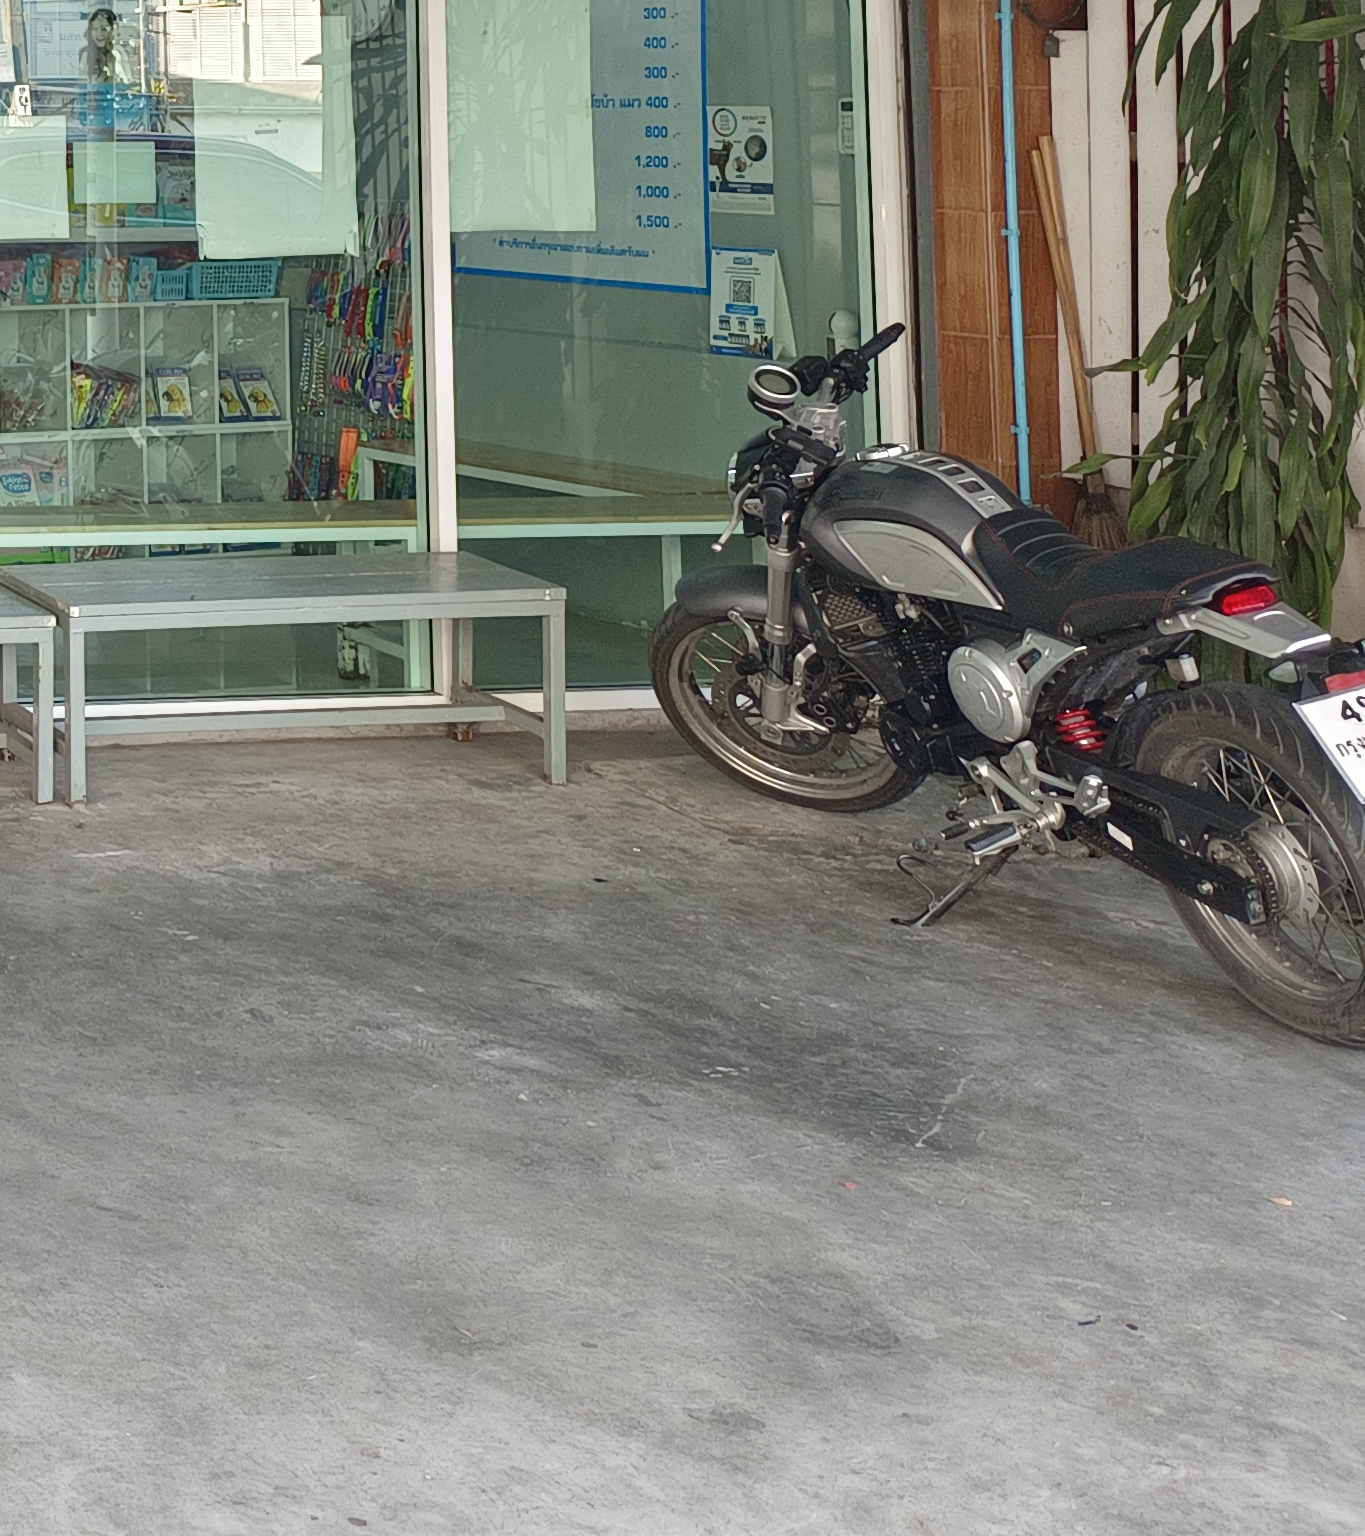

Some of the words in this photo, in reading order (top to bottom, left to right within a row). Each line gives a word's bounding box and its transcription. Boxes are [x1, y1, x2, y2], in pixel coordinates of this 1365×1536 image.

[643, 7, 667, 20] 300
[643, 37, 668, 50] 400
[644, 66, 668, 79] 300
[645, 96, 669, 109] 400
[644, 125, 668, 139] 800
[634, 154, 669, 169] 1,200
[635, 184, 670, 199] 1,000
[635, 214, 670, 229] 1,500
